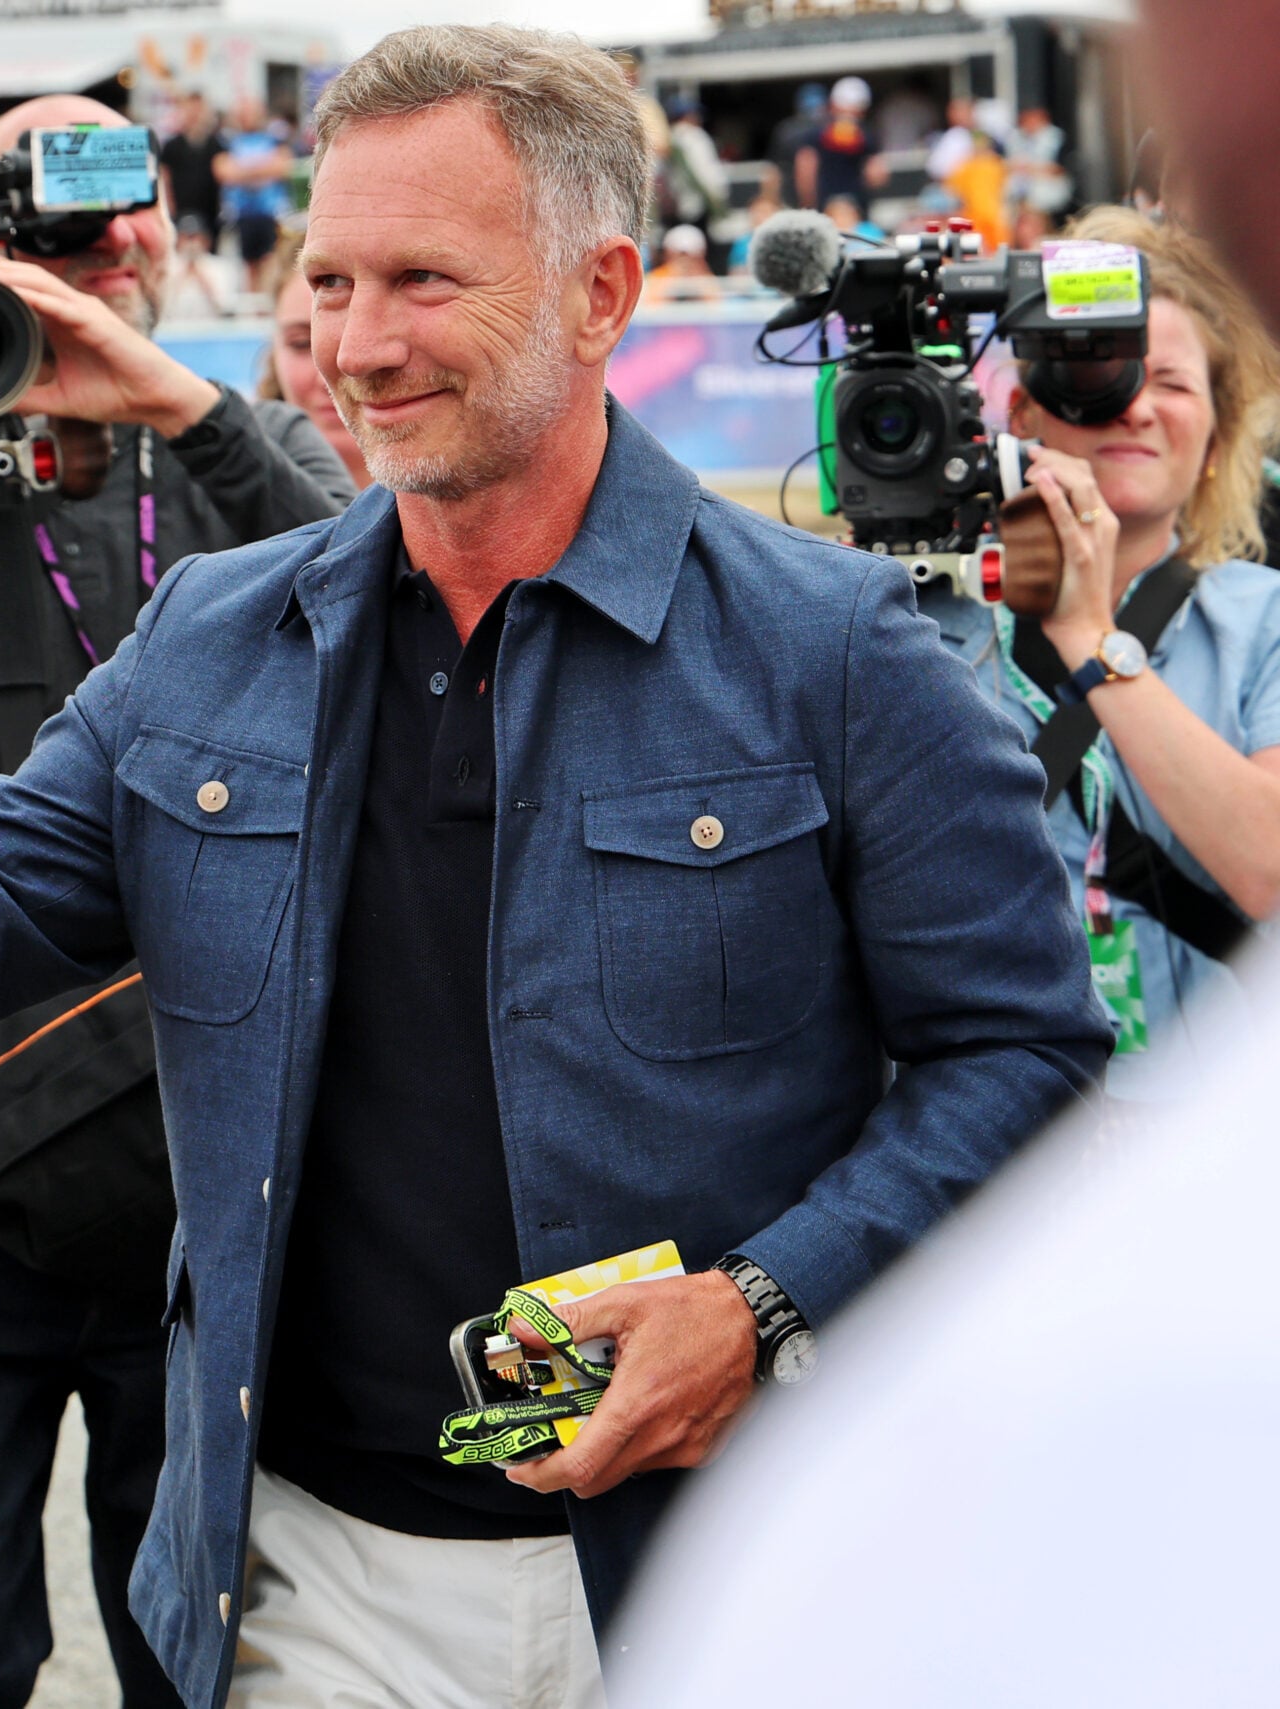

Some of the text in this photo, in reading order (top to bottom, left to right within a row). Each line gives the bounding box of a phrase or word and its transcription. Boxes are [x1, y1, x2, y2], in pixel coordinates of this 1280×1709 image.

[509, 1293, 562, 1339] 2026
[507, 1410, 527, 1420] World
[516, 1403, 543, 1412] Formula
[463, 1425, 548, 1462] VIP 2026
